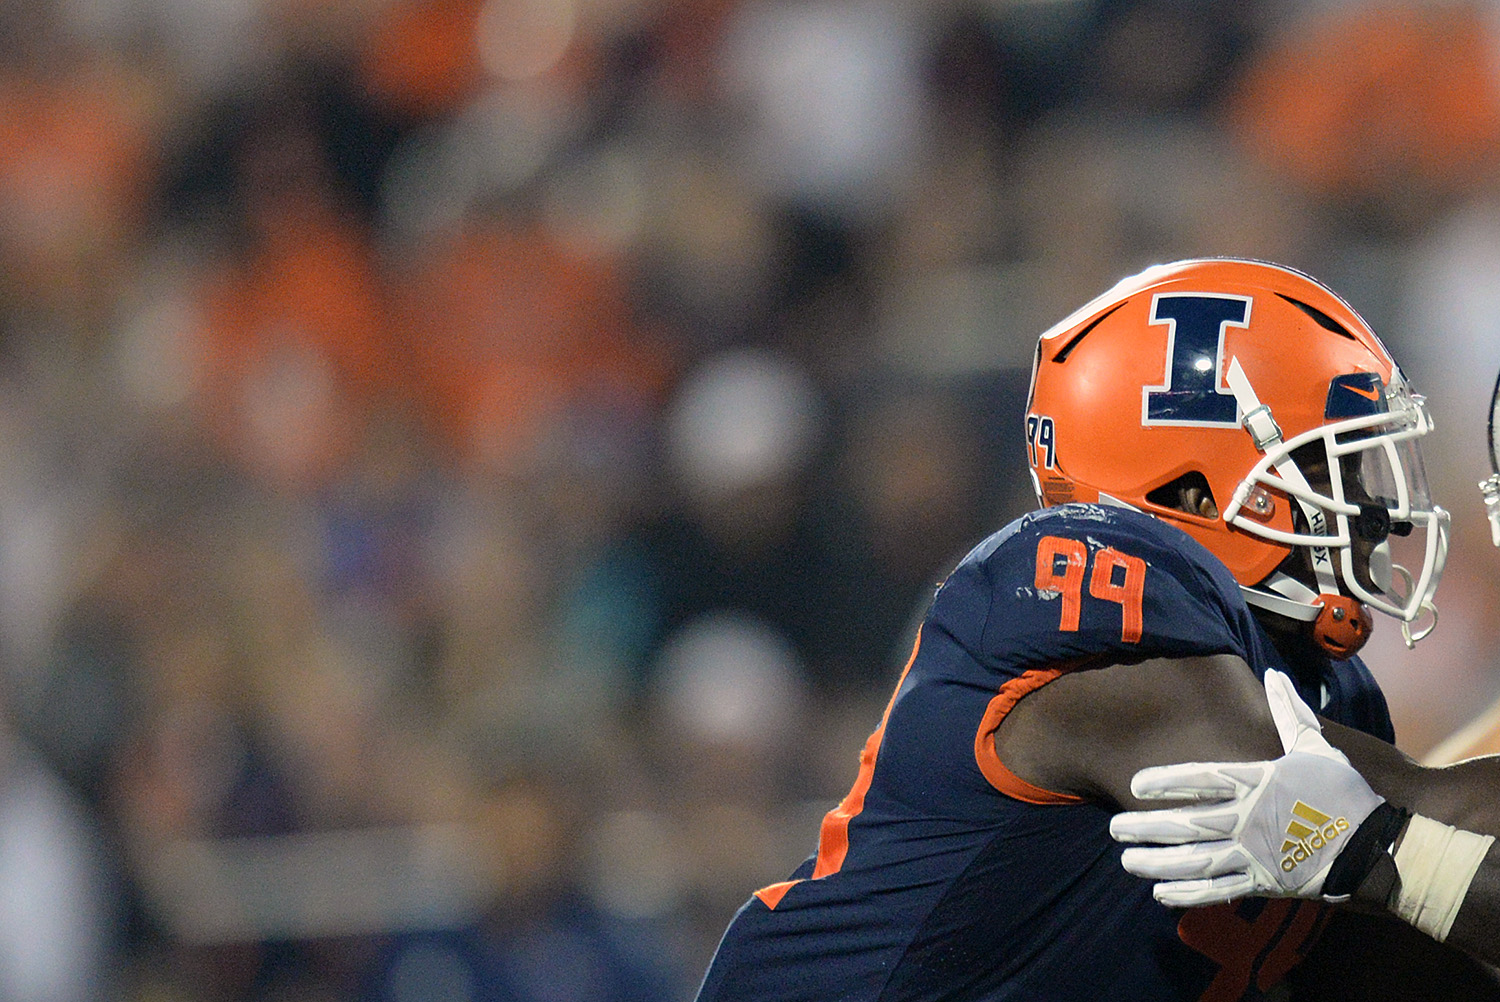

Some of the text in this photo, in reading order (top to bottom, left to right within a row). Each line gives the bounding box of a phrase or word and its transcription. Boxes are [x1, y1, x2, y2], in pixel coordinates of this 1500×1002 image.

[1141, 292, 1253, 429] I
[1034, 535, 1147, 644] 99
[1280, 815, 1349, 873] adidas
